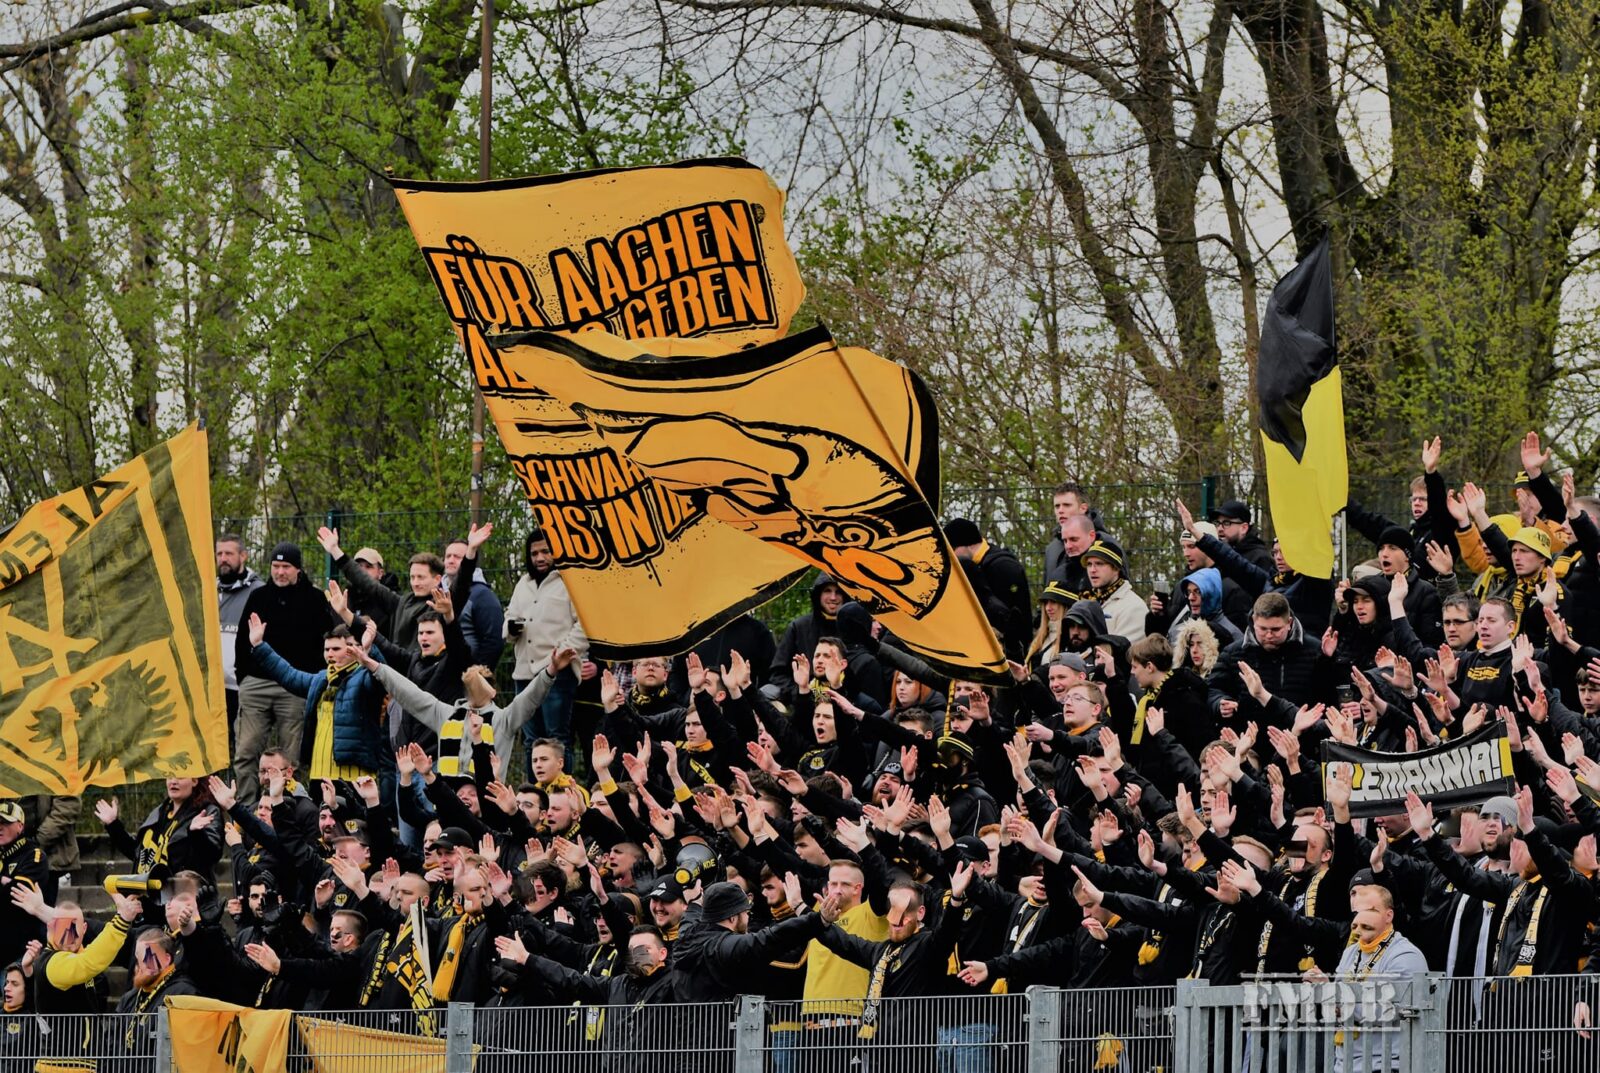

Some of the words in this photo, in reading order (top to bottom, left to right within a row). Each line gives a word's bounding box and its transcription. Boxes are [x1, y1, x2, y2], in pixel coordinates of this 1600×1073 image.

[425, 236, 544, 329] FÜR
[551, 200, 759, 324] AACHEN
[624, 264, 769, 340] GEBEN
[511, 452, 646, 502] SCHWAR
[531, 503, 600, 560] BIS
[602, 489, 657, 559] IN
